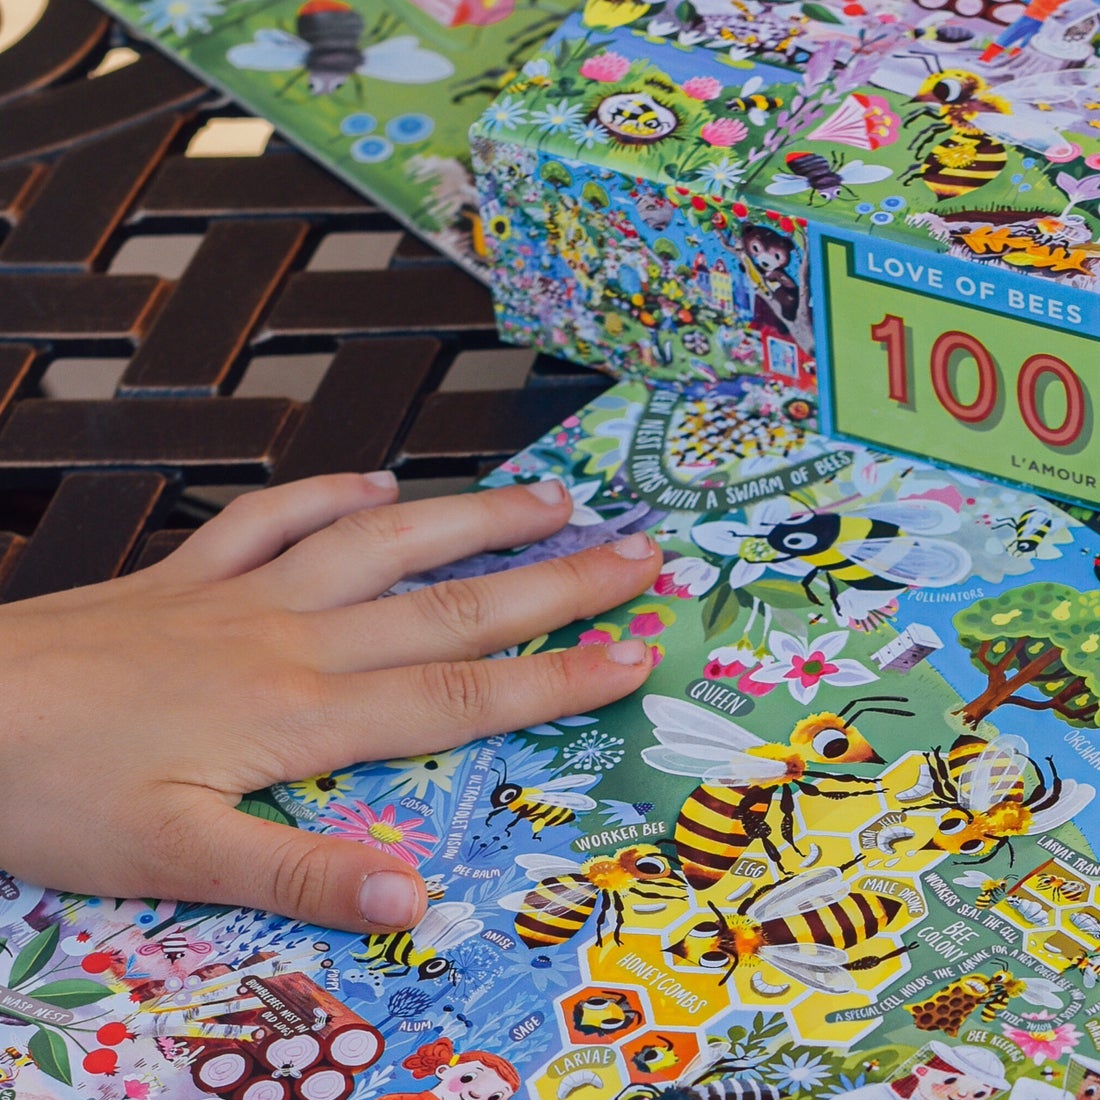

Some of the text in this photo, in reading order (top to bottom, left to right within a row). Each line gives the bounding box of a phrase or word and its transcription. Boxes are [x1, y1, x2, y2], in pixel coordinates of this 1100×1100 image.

[867, 252, 1082, 325] LOVE OF BEES
[870, 314, 1086, 447] 100
[635, 418, 665, 450] NEST
[631, 454, 669, 492] FORMS
[790, 466, 809, 486] OF
[818, 450, 852, 477] BEES
[1011, 454, 1097, 490] L'AMOUR
[657, 487, 700, 509] WITH
[706, 491, 718, 509] A
[726, 477, 784, 505] SWARM
[907, 586, 985, 603] POLLINATORS
[689, 681, 748, 715] QUEEN
[474, 746, 497, 773] HAVE
[400, 797, 435, 818] COSMO
[451, 774, 485, 834] ULTRAVIOLET
[442, 833, 465, 861] VISION
[575, 821, 667, 851] WORKER BEE
[1036, 835, 1072, 862] LARVAE
[452, 863, 500, 879] BEE BALM
[733, 859, 767, 878] EGG
[863, 878, 899, 895] MALE
[923, 872, 1019, 944] WORKERS SEAL THE CELL
[482, 930, 515, 949] ANISE
[916, 926, 969, 963] COLONY
[942, 921, 979, 945] BEE
[616, 952, 707, 1014] HONEYCOMBS
[834, 1013, 844, 1022] A
[844, 1008, 882, 1021] SPECIAL
[880, 994, 904, 1012] CELL
[899, 975, 931, 998] HOLDS
[933, 966, 955, 980] THE
[957, 949, 991, 974] LARVAE
[4, 995, 70, 1025] WASP NEST
[260, 1011, 275, 1026] OLD
[278, 1007, 299, 1026] NEST
[297, 1022, 309, 1034] IN
[399, 1019, 432, 1032] ALUM
[512, 1016, 541, 1041] SAGE
[966, 1030, 987, 1042] BEE
[553, 1048, 612, 1076] LARVAE
